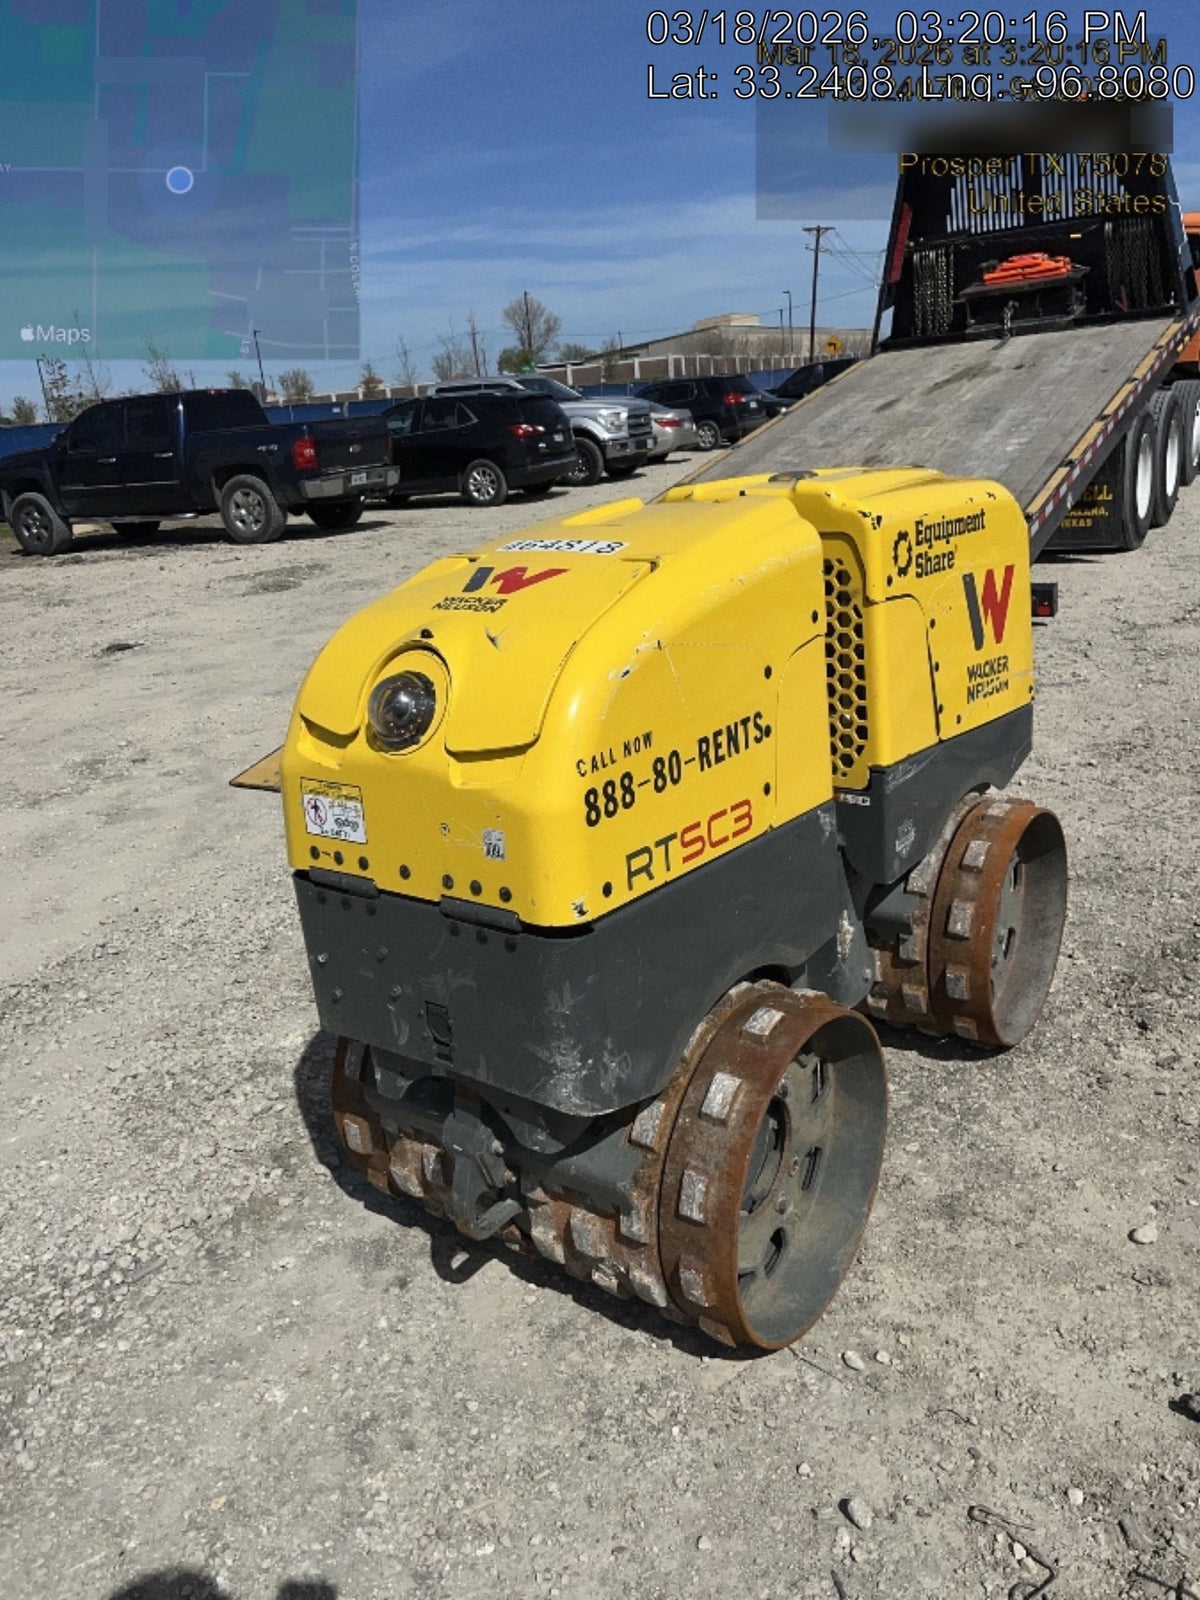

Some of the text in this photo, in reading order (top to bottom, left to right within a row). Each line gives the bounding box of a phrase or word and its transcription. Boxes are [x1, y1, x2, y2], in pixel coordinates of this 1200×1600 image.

[915, 508, 985, 549] Equipment
[915, 550, 954, 579] Share
[967, 655, 1009, 683] WACKER
[576, 731, 653, 777] CALL NOW
[584, 711, 764, 827] 888-80-RENTS
[625, 799, 753, 891] RTSC3
